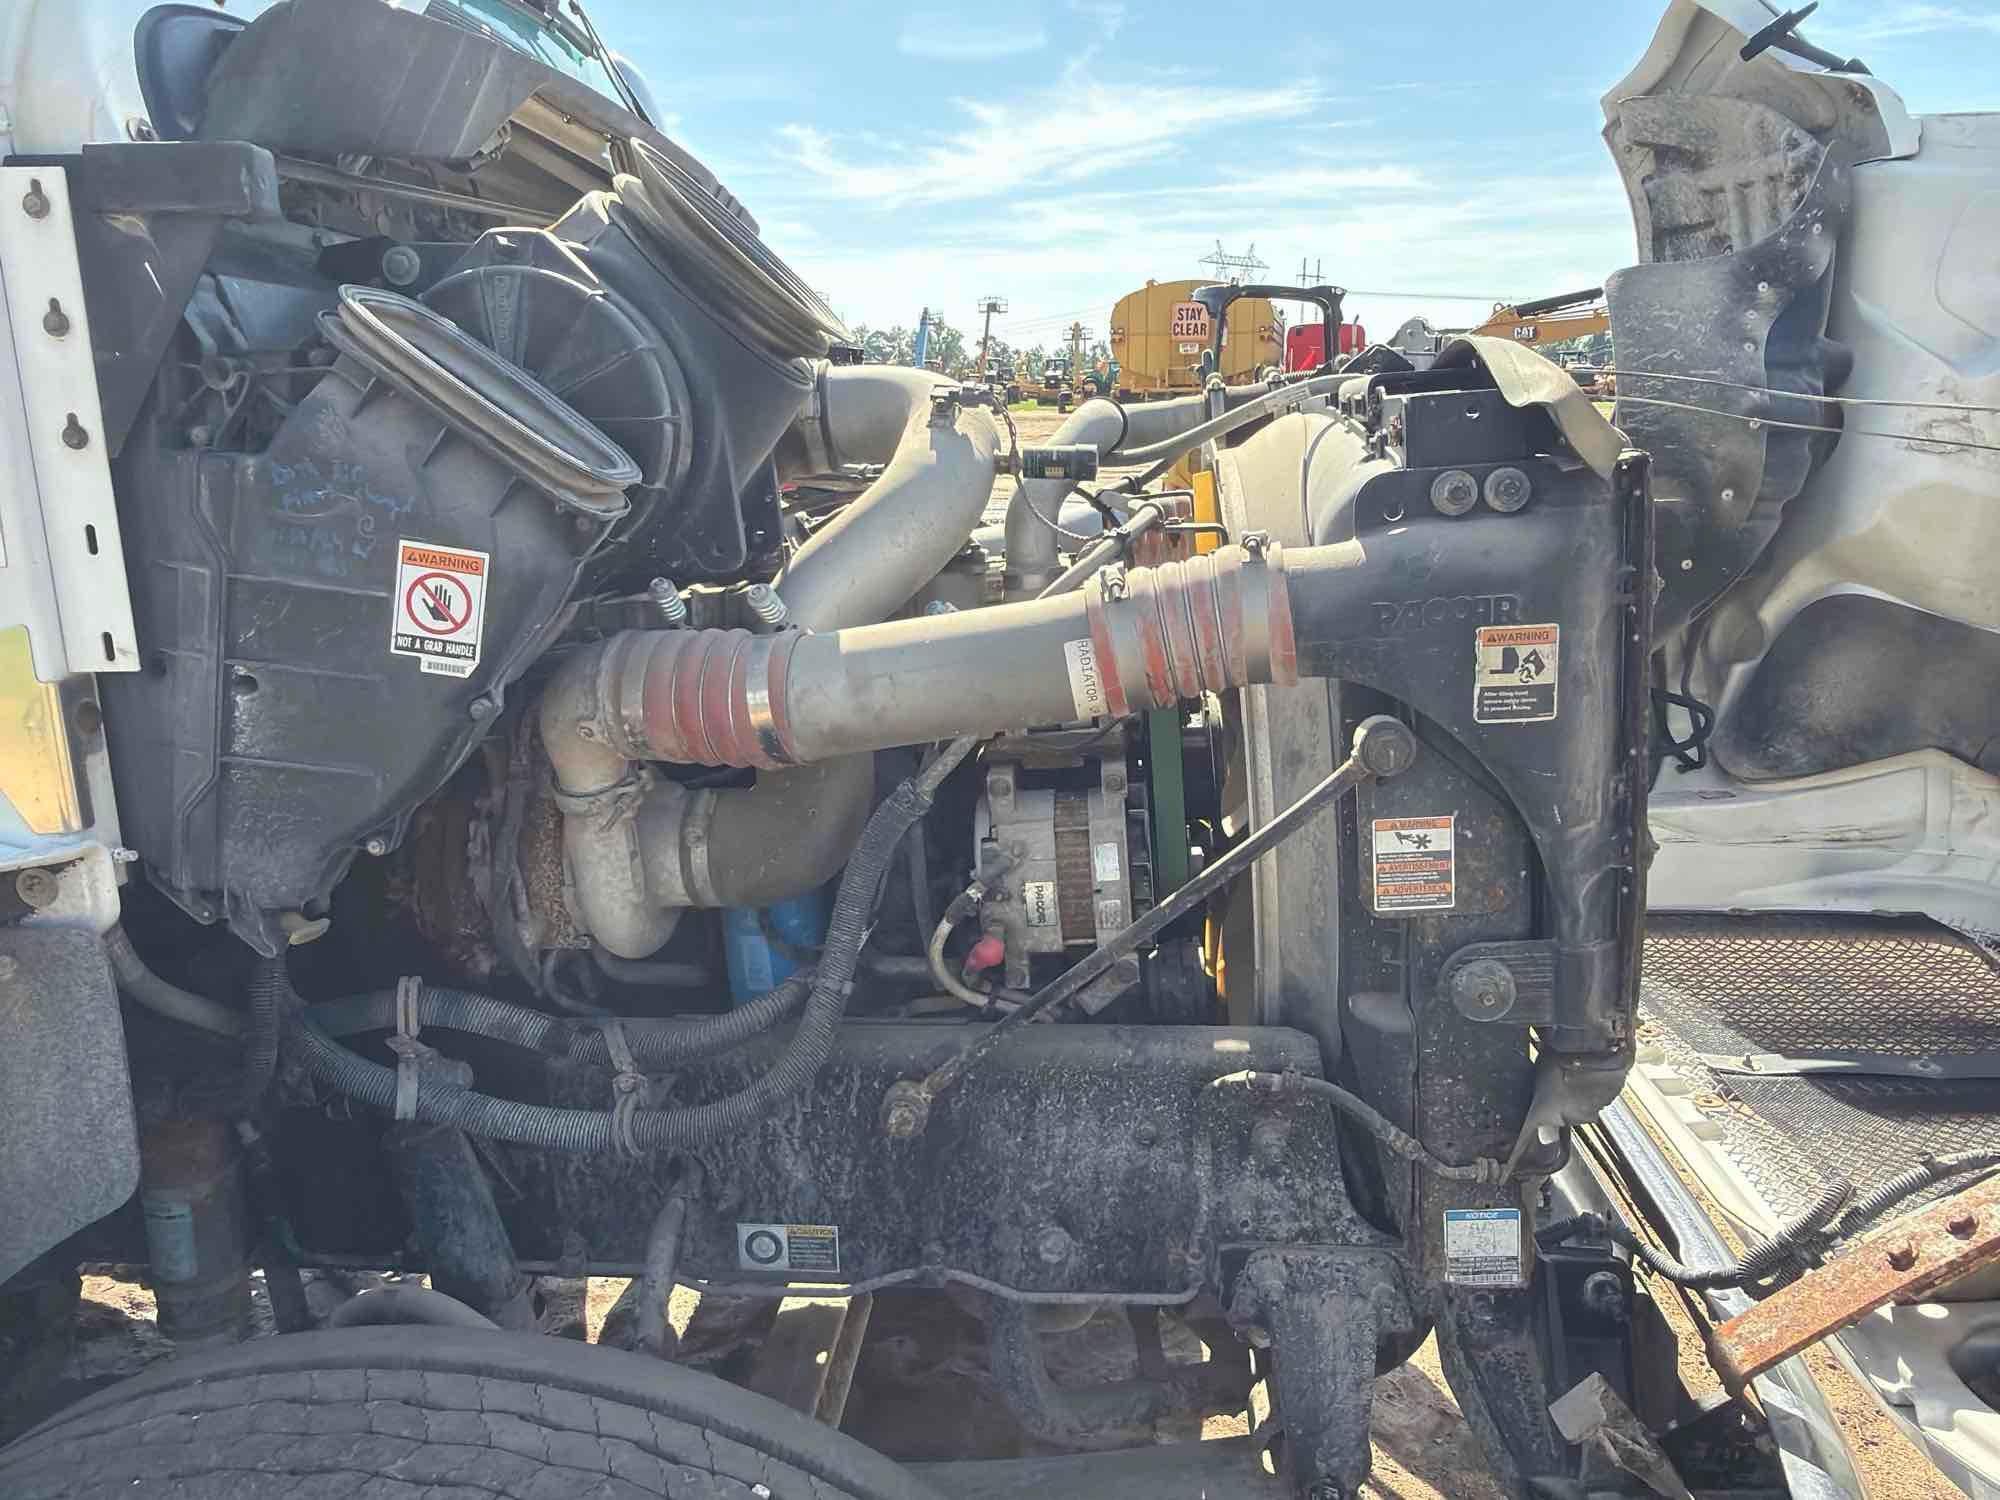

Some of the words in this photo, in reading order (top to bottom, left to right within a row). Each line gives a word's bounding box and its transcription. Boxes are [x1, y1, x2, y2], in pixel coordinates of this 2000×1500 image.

[1177, 307, 1203, 321] STAY
[1173, 322, 1207, 336] CLEAR
[1514, 326, 1536, 339] CAT
[419, 552, 480, 571] WARNING
[1495, 631, 1549, 641] WARNING
[396, 636, 413, 648] NOT
[414, 637, 421, 649] A
[424, 639, 443, 651] GRAB
[446, 642, 475, 657] HANDLE
[1079, 640, 1099, 702] RADIATOR
